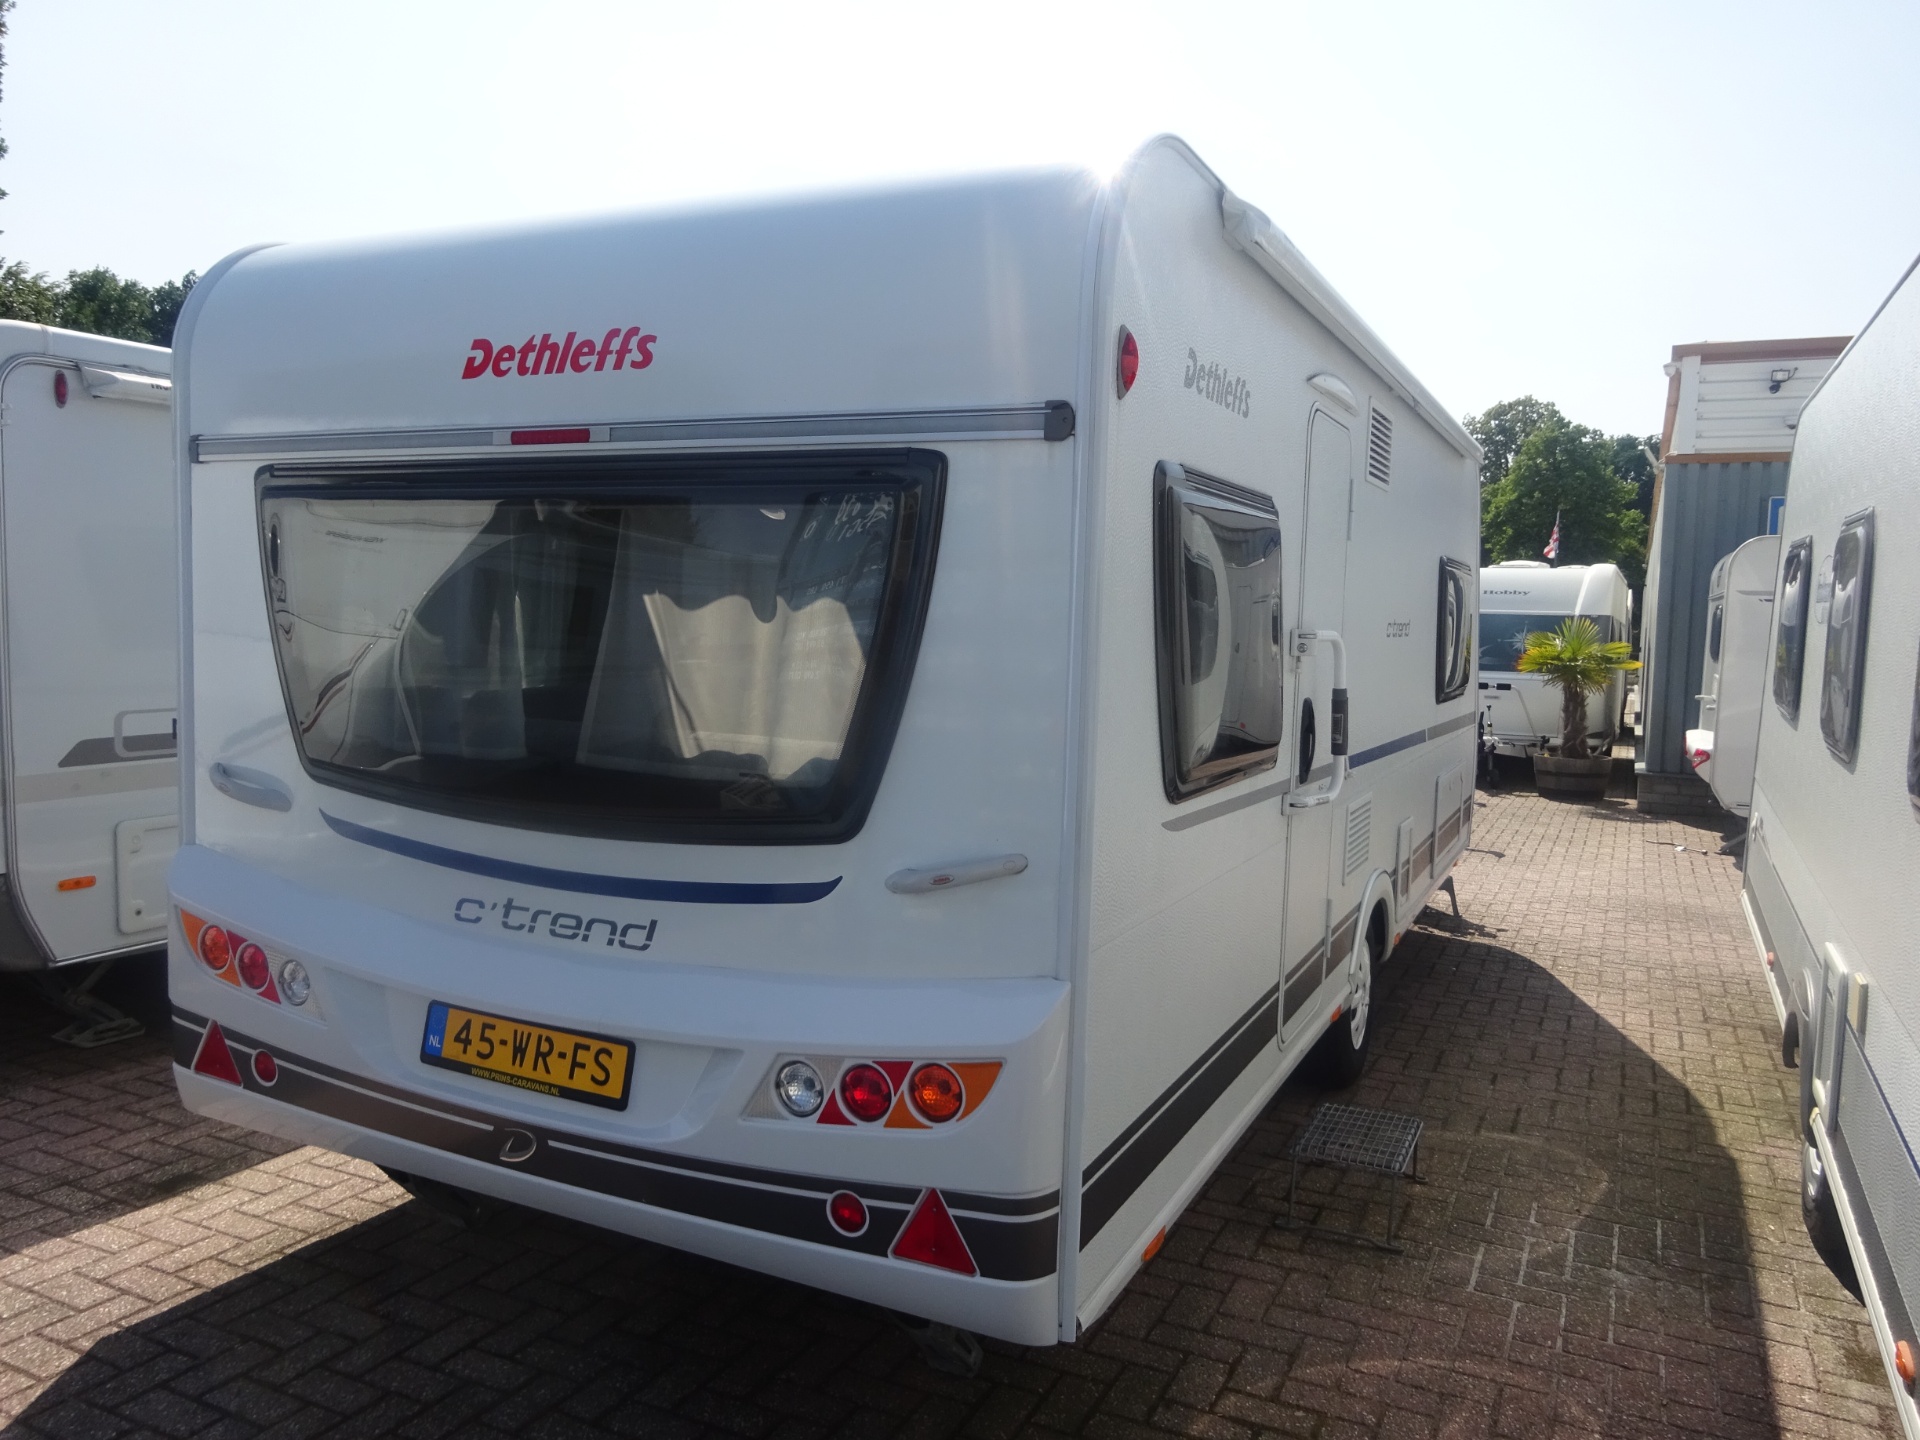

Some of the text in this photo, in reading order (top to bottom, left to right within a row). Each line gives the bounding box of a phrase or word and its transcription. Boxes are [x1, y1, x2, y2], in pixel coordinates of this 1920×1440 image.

[461, 326, 658, 380] Dethleffs
[1183, 346, 1251, 419] Dethleffs
[1482, 589, 1531, 597] Hobby
[454, 897, 658, 951] c'trend
[429, 1036, 441, 1048] NL
[453, 1018, 613, 1087] 45-WR-FS
[471, 1067, 560, 1096] WWW.PRINS-CARAVANS.NL
